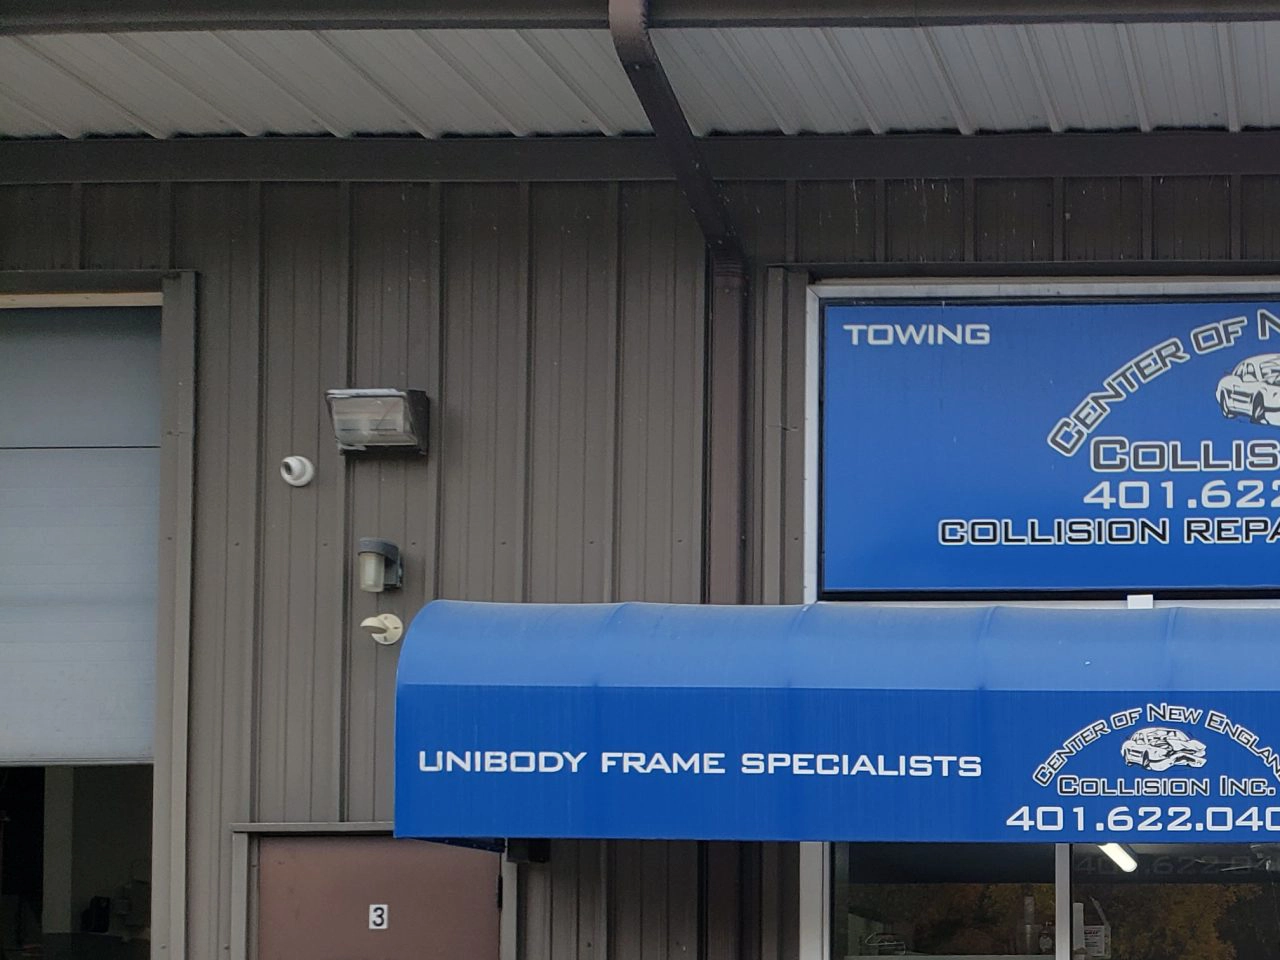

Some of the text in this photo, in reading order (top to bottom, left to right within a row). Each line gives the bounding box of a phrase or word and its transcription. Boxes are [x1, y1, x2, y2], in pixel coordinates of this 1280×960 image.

[843, 324, 991, 345] TOWING
[1047, 337, 1191, 457] CENTER
[1190, 316, 1248, 355] OF
[937, 517, 1170, 546] COLLISION
[1032, 720, 1111, 787] CENTER
[1110, 707, 1143, 731] OF
[1146, 702, 1204, 724] NEW
[418, 750, 983, 777] UNIBODY FRAME SPECIALISTS
[1056, 774, 1277, 797] COLLISION INC.
[372, 907, 385, 927] 3
